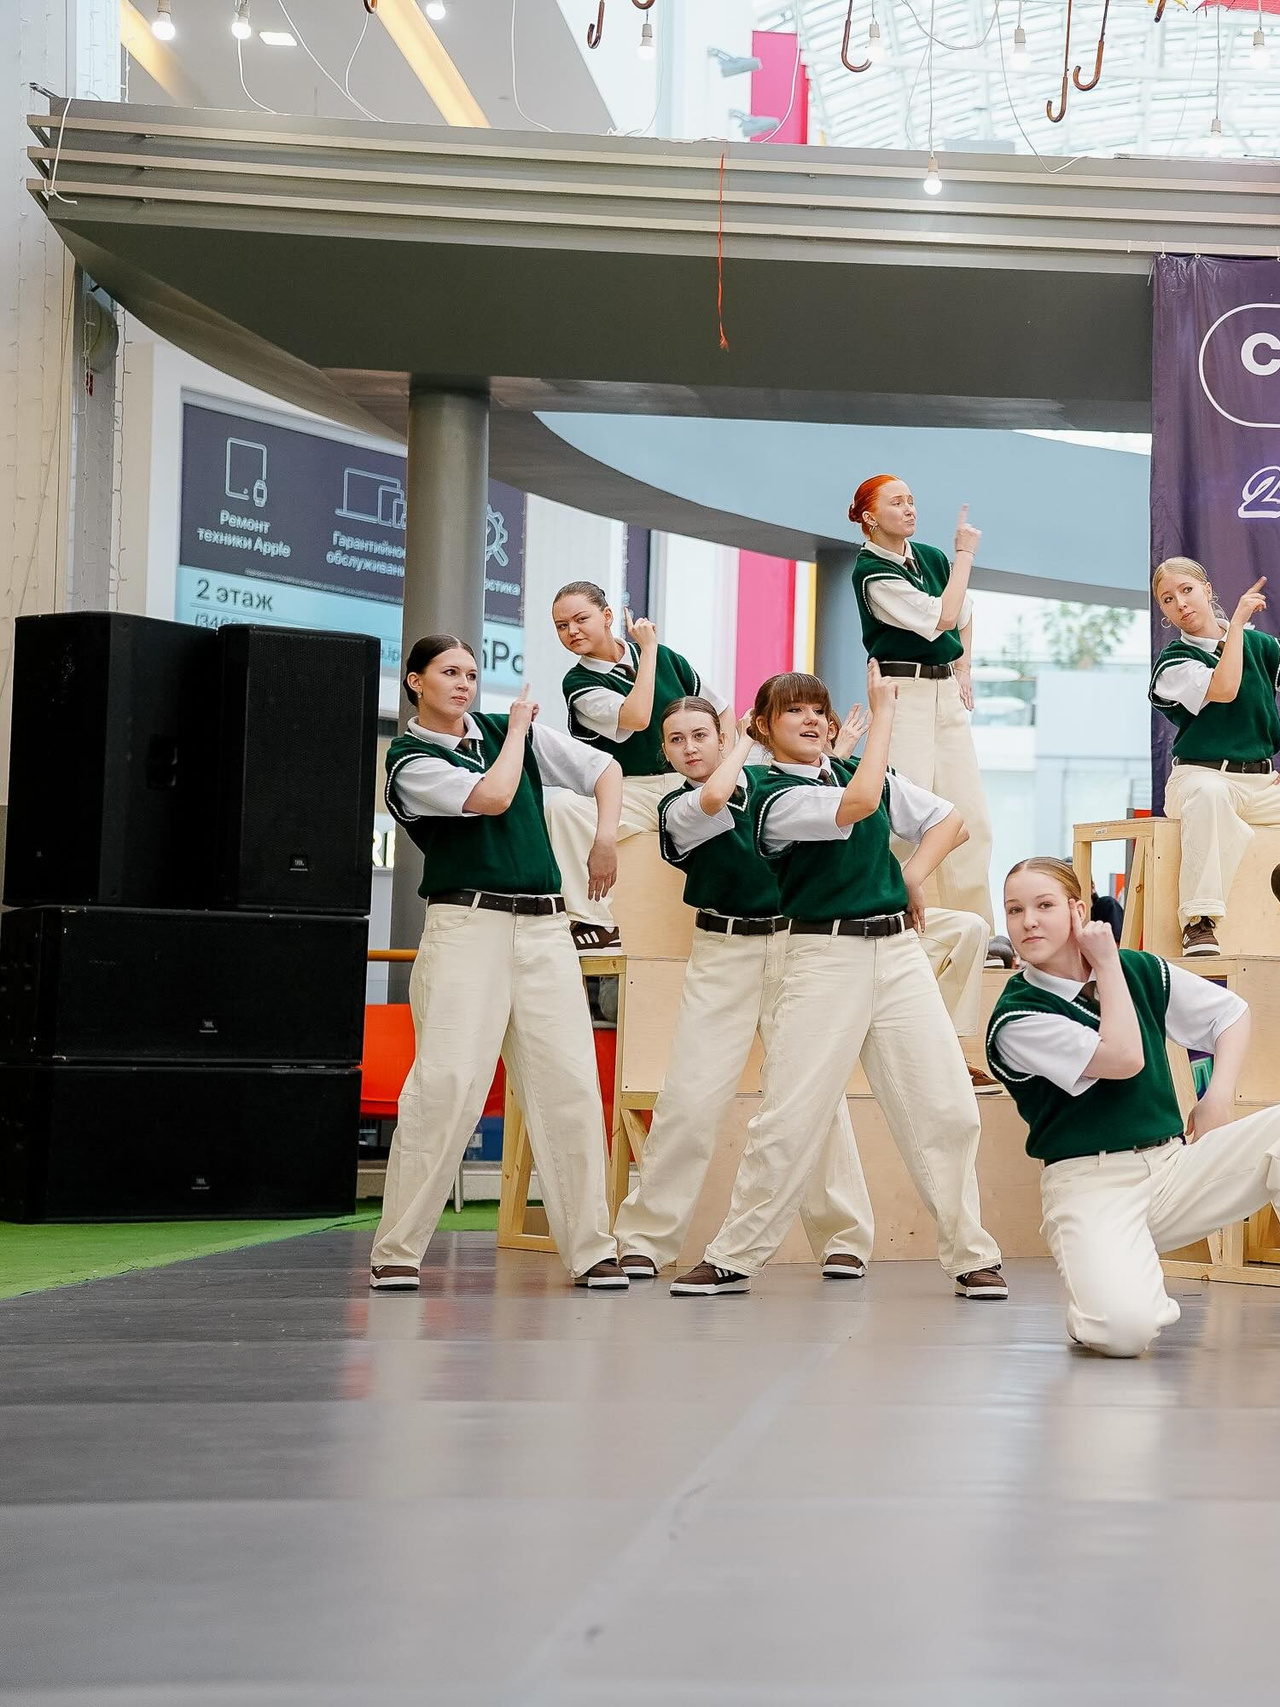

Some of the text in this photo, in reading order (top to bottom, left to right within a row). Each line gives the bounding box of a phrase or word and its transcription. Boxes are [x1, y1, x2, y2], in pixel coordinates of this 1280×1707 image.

[220, 509, 271, 534] Ремонт
[197, 527, 292, 558] техники Apple
[332, 530, 406, 559] Гарантийно
[196, 578, 273, 612] 2 этаж
